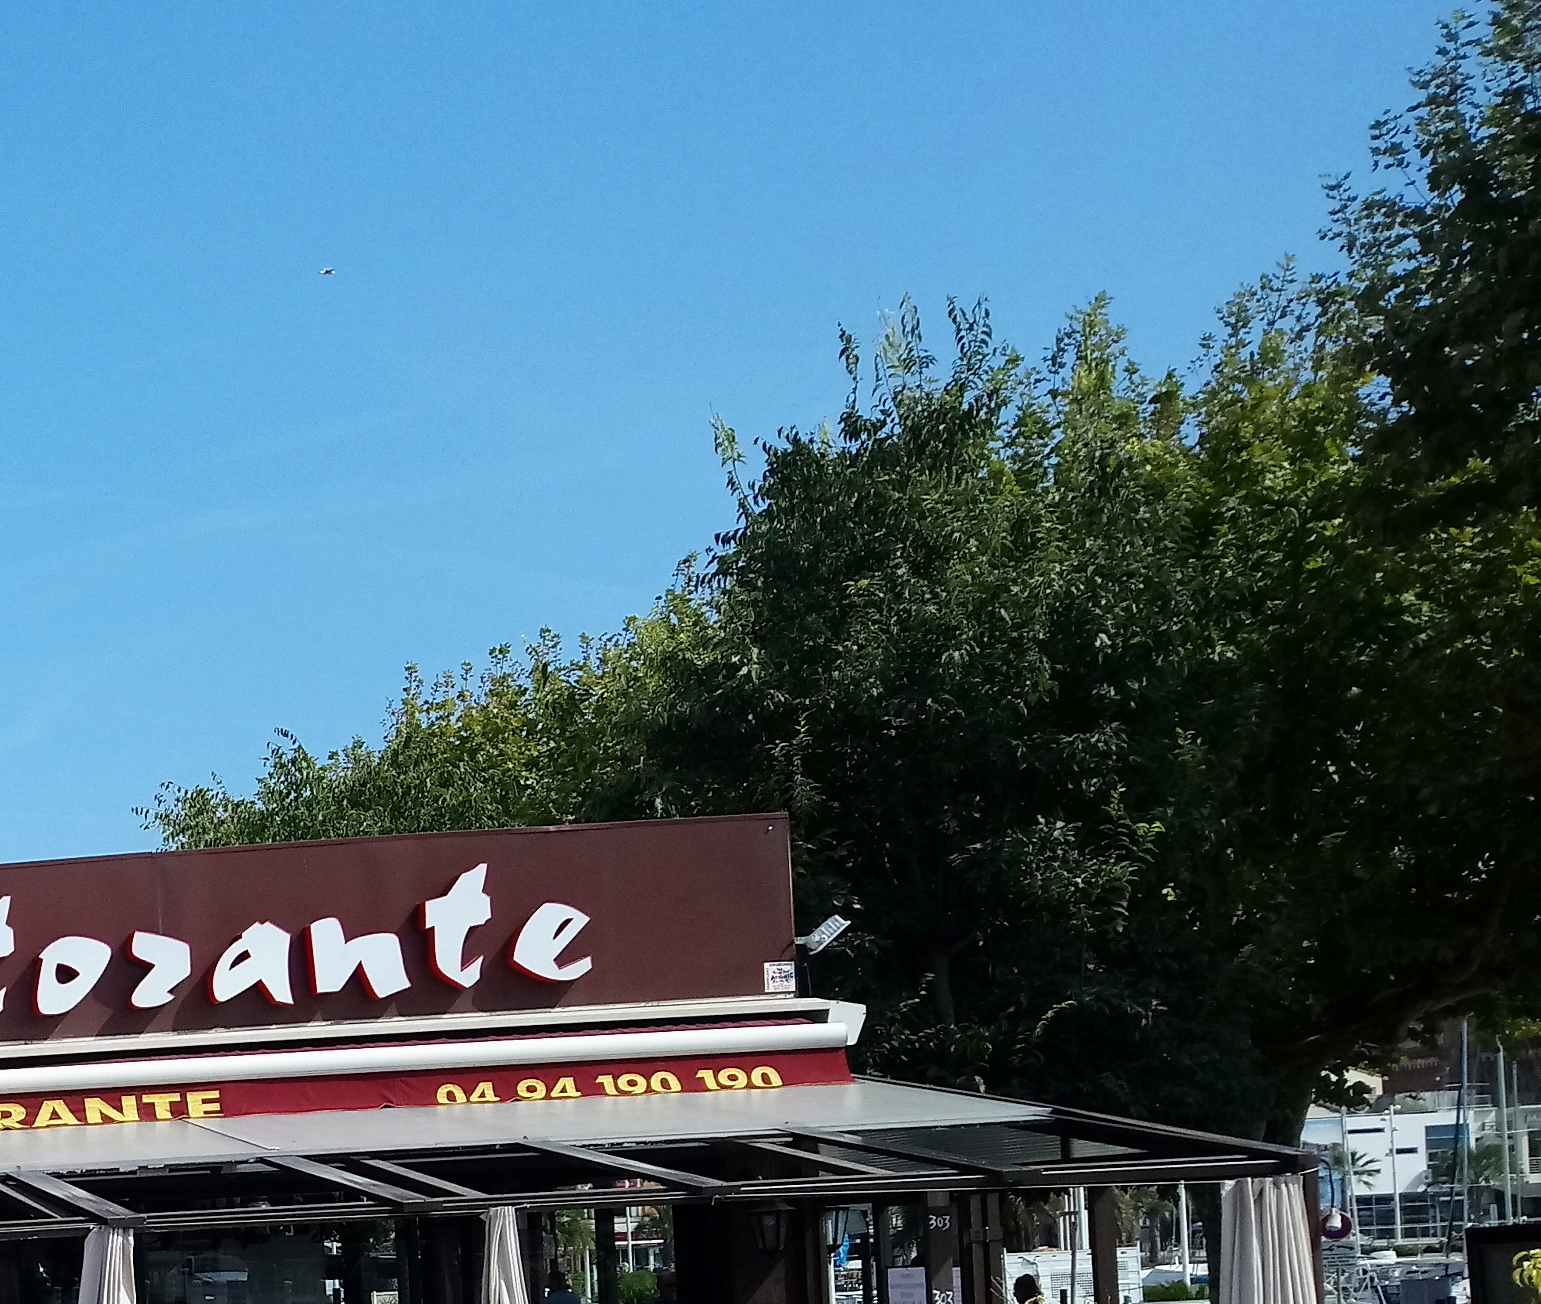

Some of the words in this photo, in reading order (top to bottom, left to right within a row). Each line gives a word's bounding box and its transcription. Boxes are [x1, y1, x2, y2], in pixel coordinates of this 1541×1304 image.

[436, 1081, 500, 1106] 04
[516, 1076, 582, 1102] 94
[596, 1070, 681, 1096] 190
[695, 1065, 784, 1091] 190
[928, 1214, 951, 1231] 303
